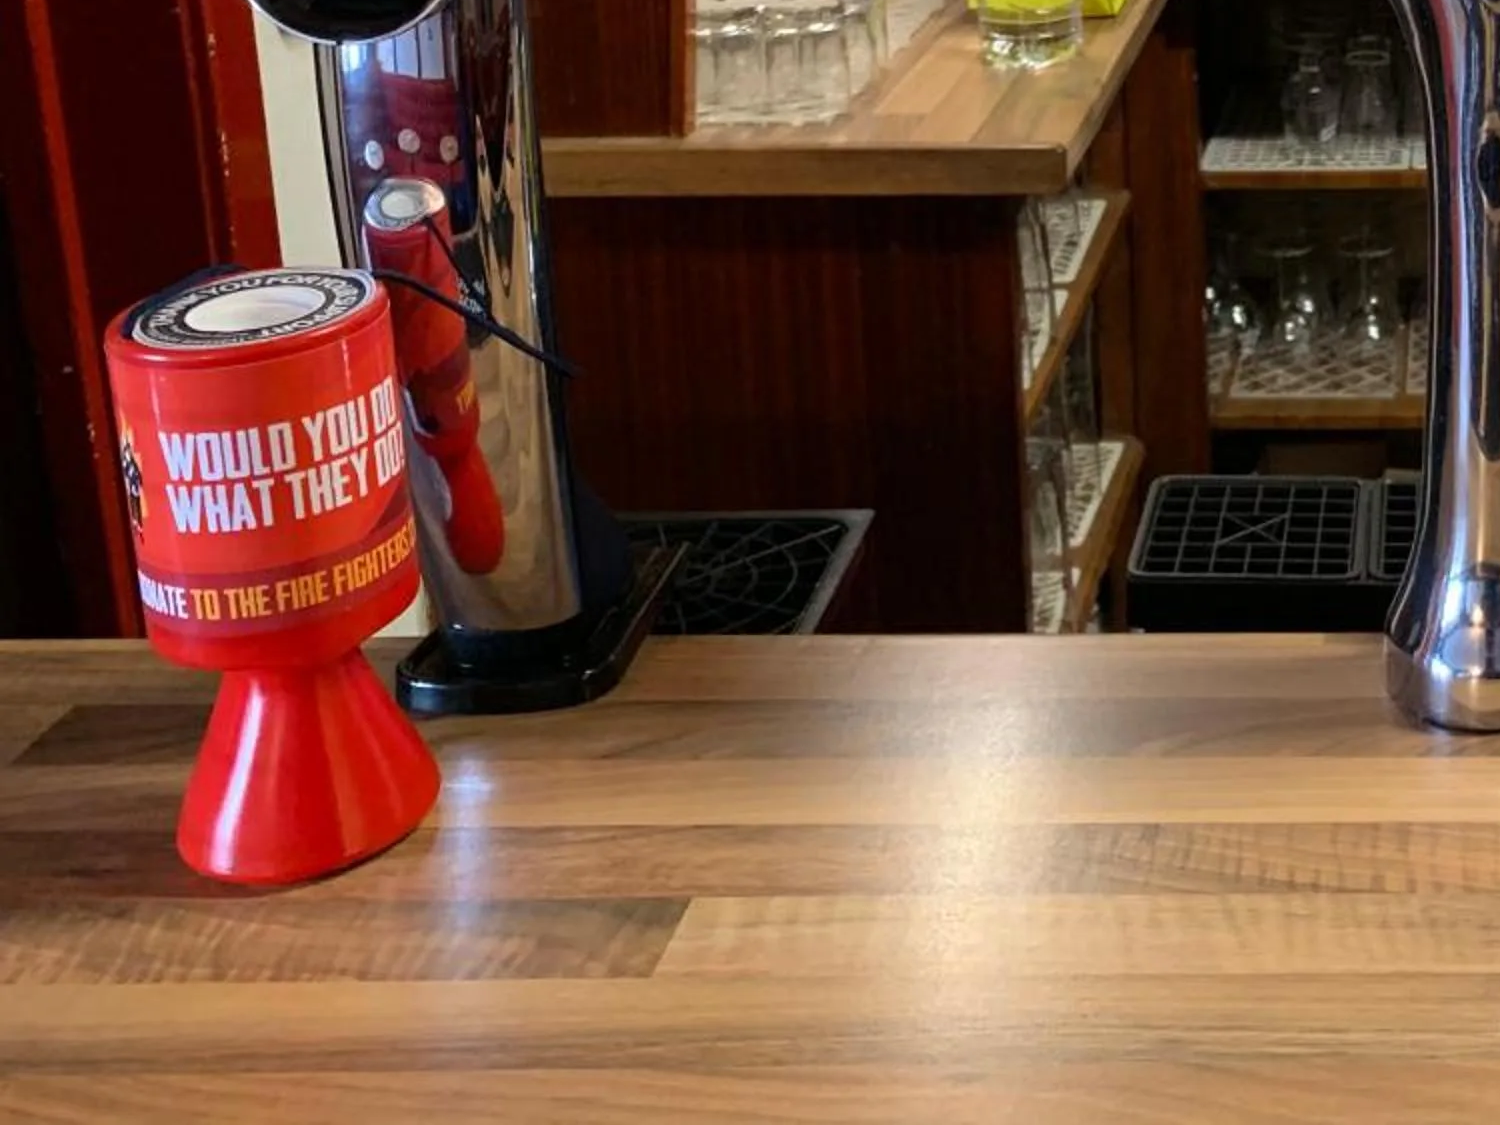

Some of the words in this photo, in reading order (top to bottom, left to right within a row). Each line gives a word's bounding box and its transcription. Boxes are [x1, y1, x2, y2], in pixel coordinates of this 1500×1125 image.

[200, 277, 261, 297] YOU
[159, 422, 297, 482] WOULD
[301, 396, 369, 461] YOU
[370, 374, 396, 430] DO
[166, 478, 275, 534] WHAT
[284, 446, 370, 520] THEY
[191, 589, 221, 621] TO
[224, 585, 273, 620] THE
[276, 570, 329, 614] FIRE
[332, 536, 413, 599] FIGHTERS
